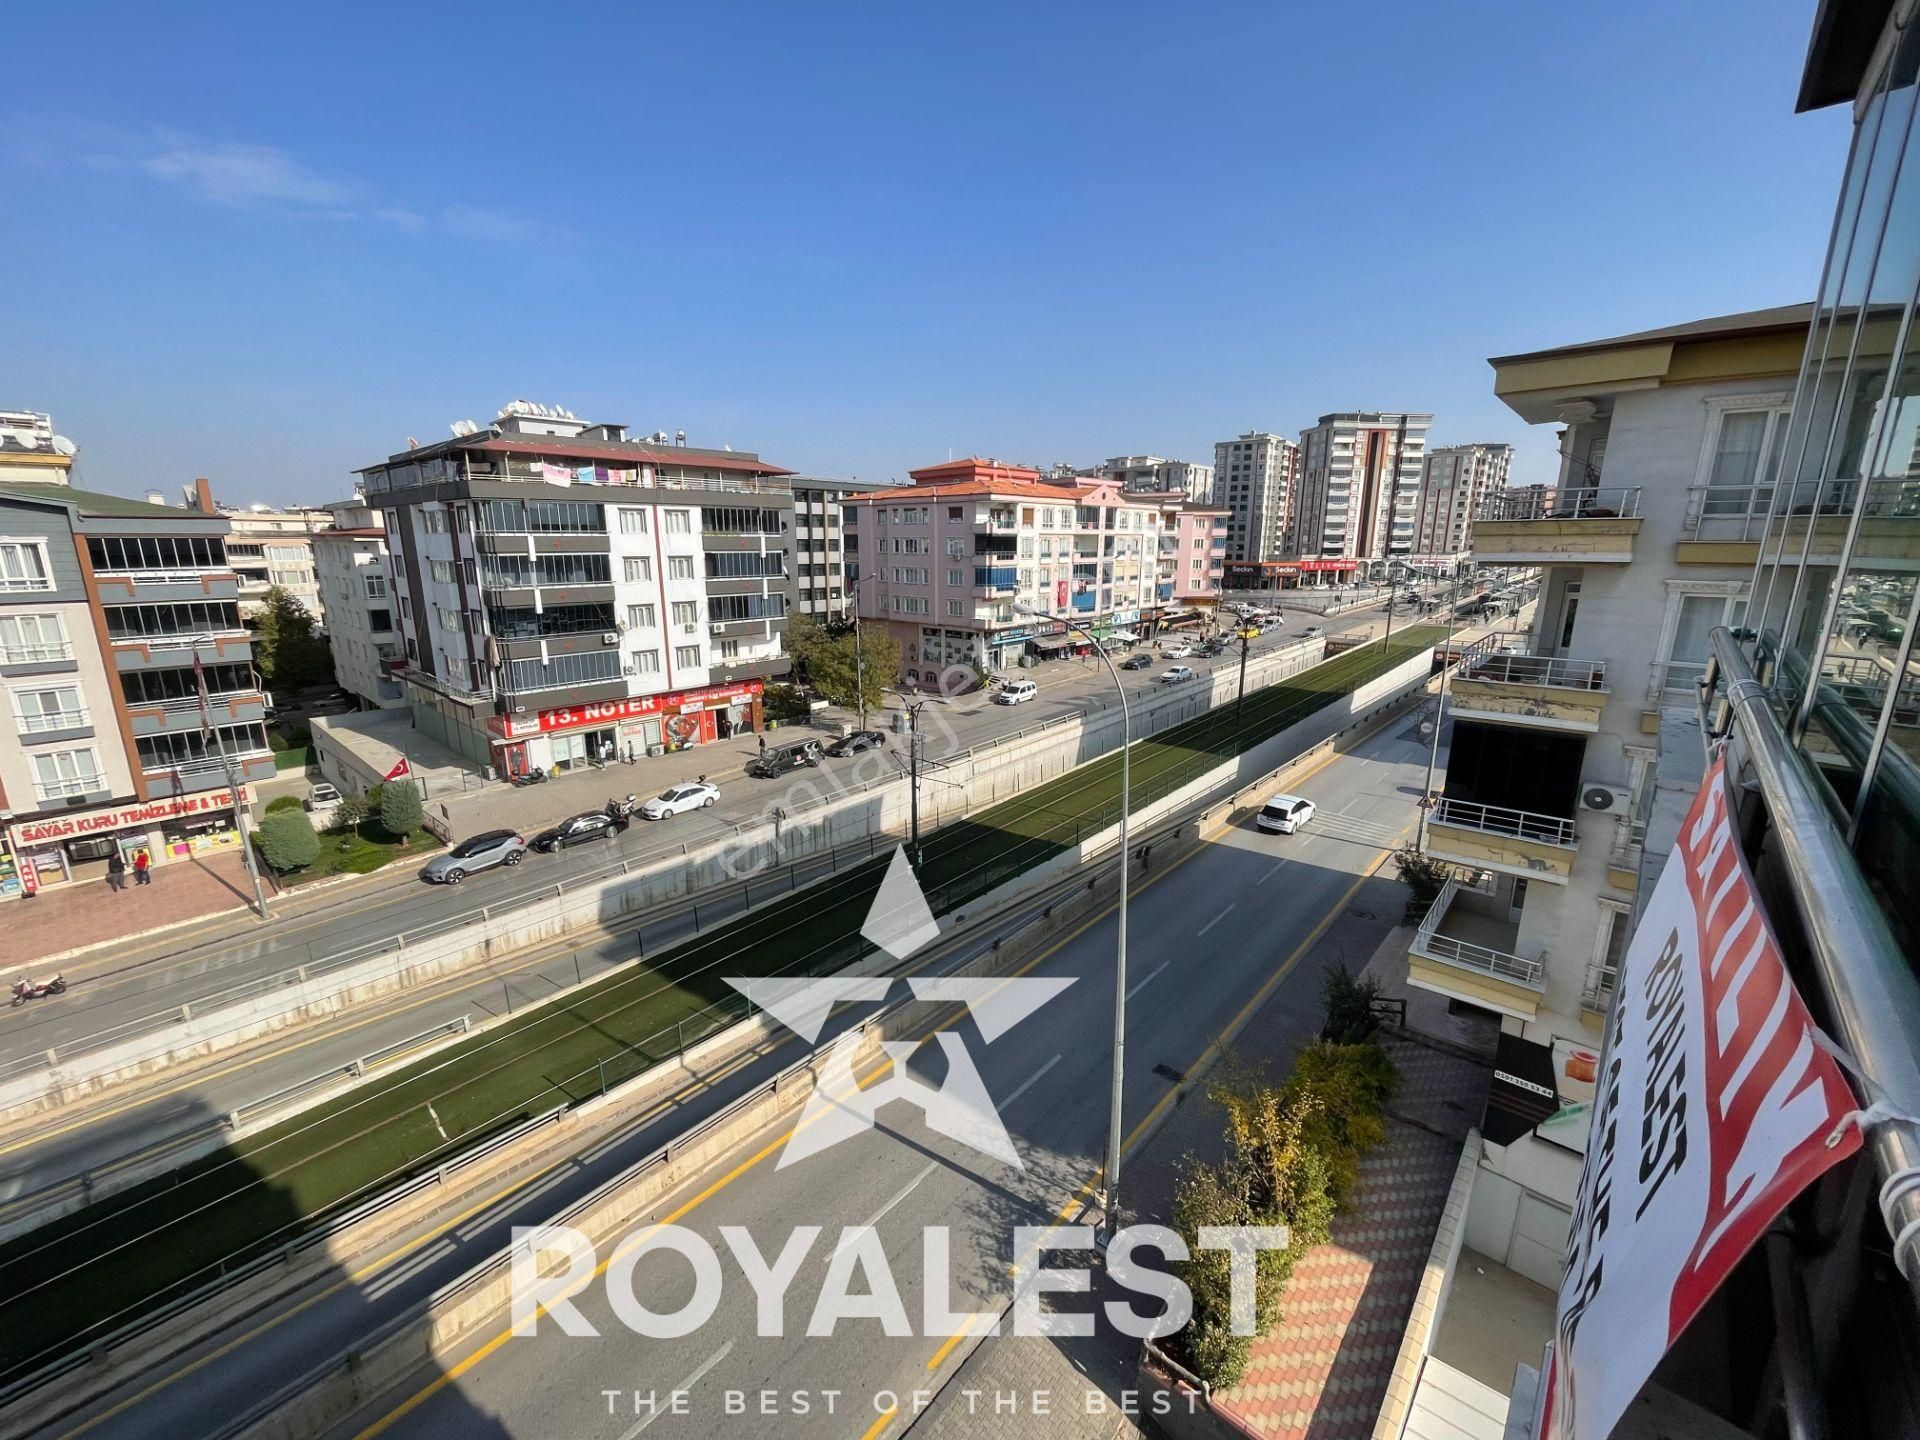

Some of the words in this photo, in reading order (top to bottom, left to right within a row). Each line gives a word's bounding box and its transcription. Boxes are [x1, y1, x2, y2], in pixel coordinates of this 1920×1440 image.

[546, 708, 578, 727] 13.
[584, 695, 656, 719] NOTER
[21, 822, 75, 842] SAYAR
[77, 814, 119, 832] KURU
[121, 799, 199, 824] TEMİZLEME
[211, 786, 248, 807] TEZİ
[1635, 926, 1688, 1223] ROYALEST
